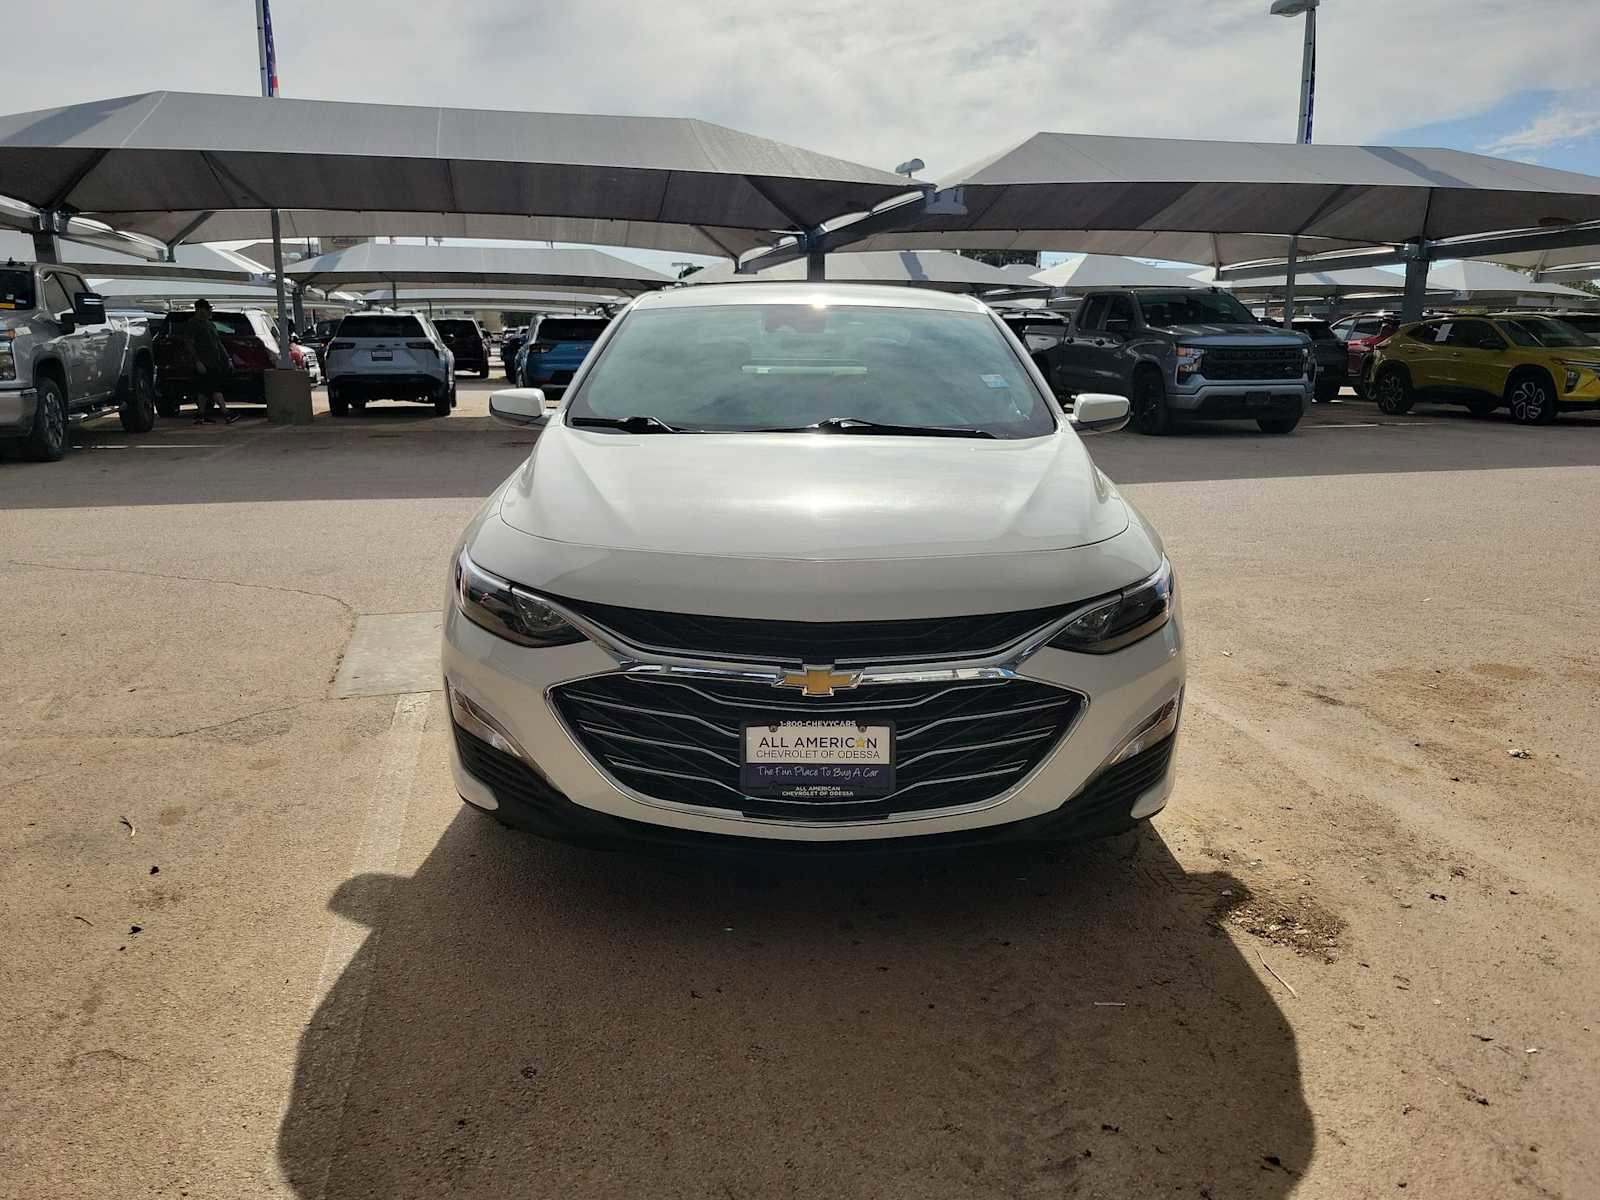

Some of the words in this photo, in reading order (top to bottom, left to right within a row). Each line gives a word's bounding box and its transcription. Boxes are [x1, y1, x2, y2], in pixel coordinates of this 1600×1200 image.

[759, 737, 789, 748] ALL
[756, 750, 818, 759] CHEVROLET
[821, 750, 834, 759] OF
[838, 750, 880, 759] ODESSA
[757, 766, 774, 776] The
[775, 766, 793, 777] Fun
[794, 766, 819, 777] Place
[821, 767, 832, 777] To
[833, 768, 852, 780] Buy
[852, 768, 861, 778] A
[862, 768, 879, 778] Car
